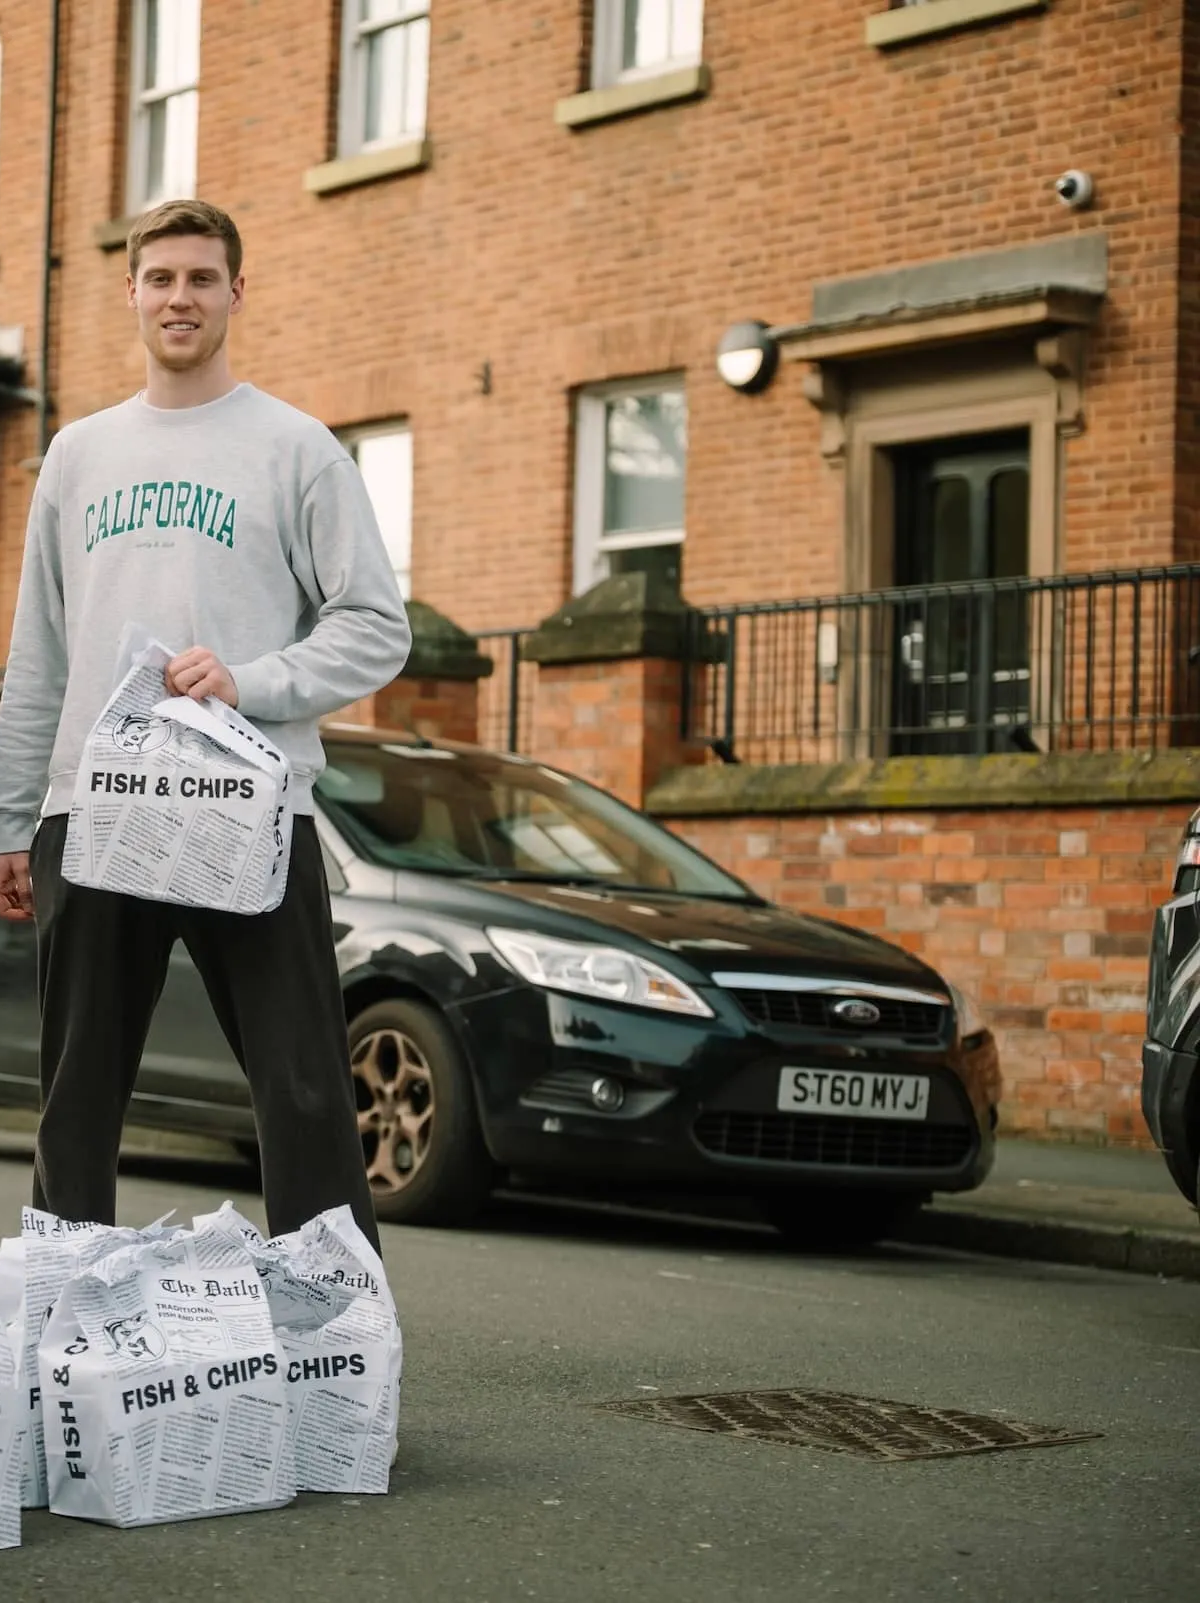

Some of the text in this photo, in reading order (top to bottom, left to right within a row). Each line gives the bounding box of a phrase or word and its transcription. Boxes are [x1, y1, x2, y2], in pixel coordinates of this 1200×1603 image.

[85, 480, 237, 553] CALIFORNIA
[90, 771, 255, 799] FISH & CHIPS
[792, 1071, 920, 1111] ST60 MYJ
[158, 1278, 199, 1297] The
[202, 1279, 262, 1303] Daily
[154, 1302, 214, 1315] TRADITIONAL
[53, 1363, 71, 1388] &
[121, 1379, 176, 1414] FISH
[184, 1374, 201, 1398] &
[207, 1353, 279, 1391] CHIPS
[286, 1352, 366, 1384] CHIPS
[58, 1401, 87, 1480] FISH
